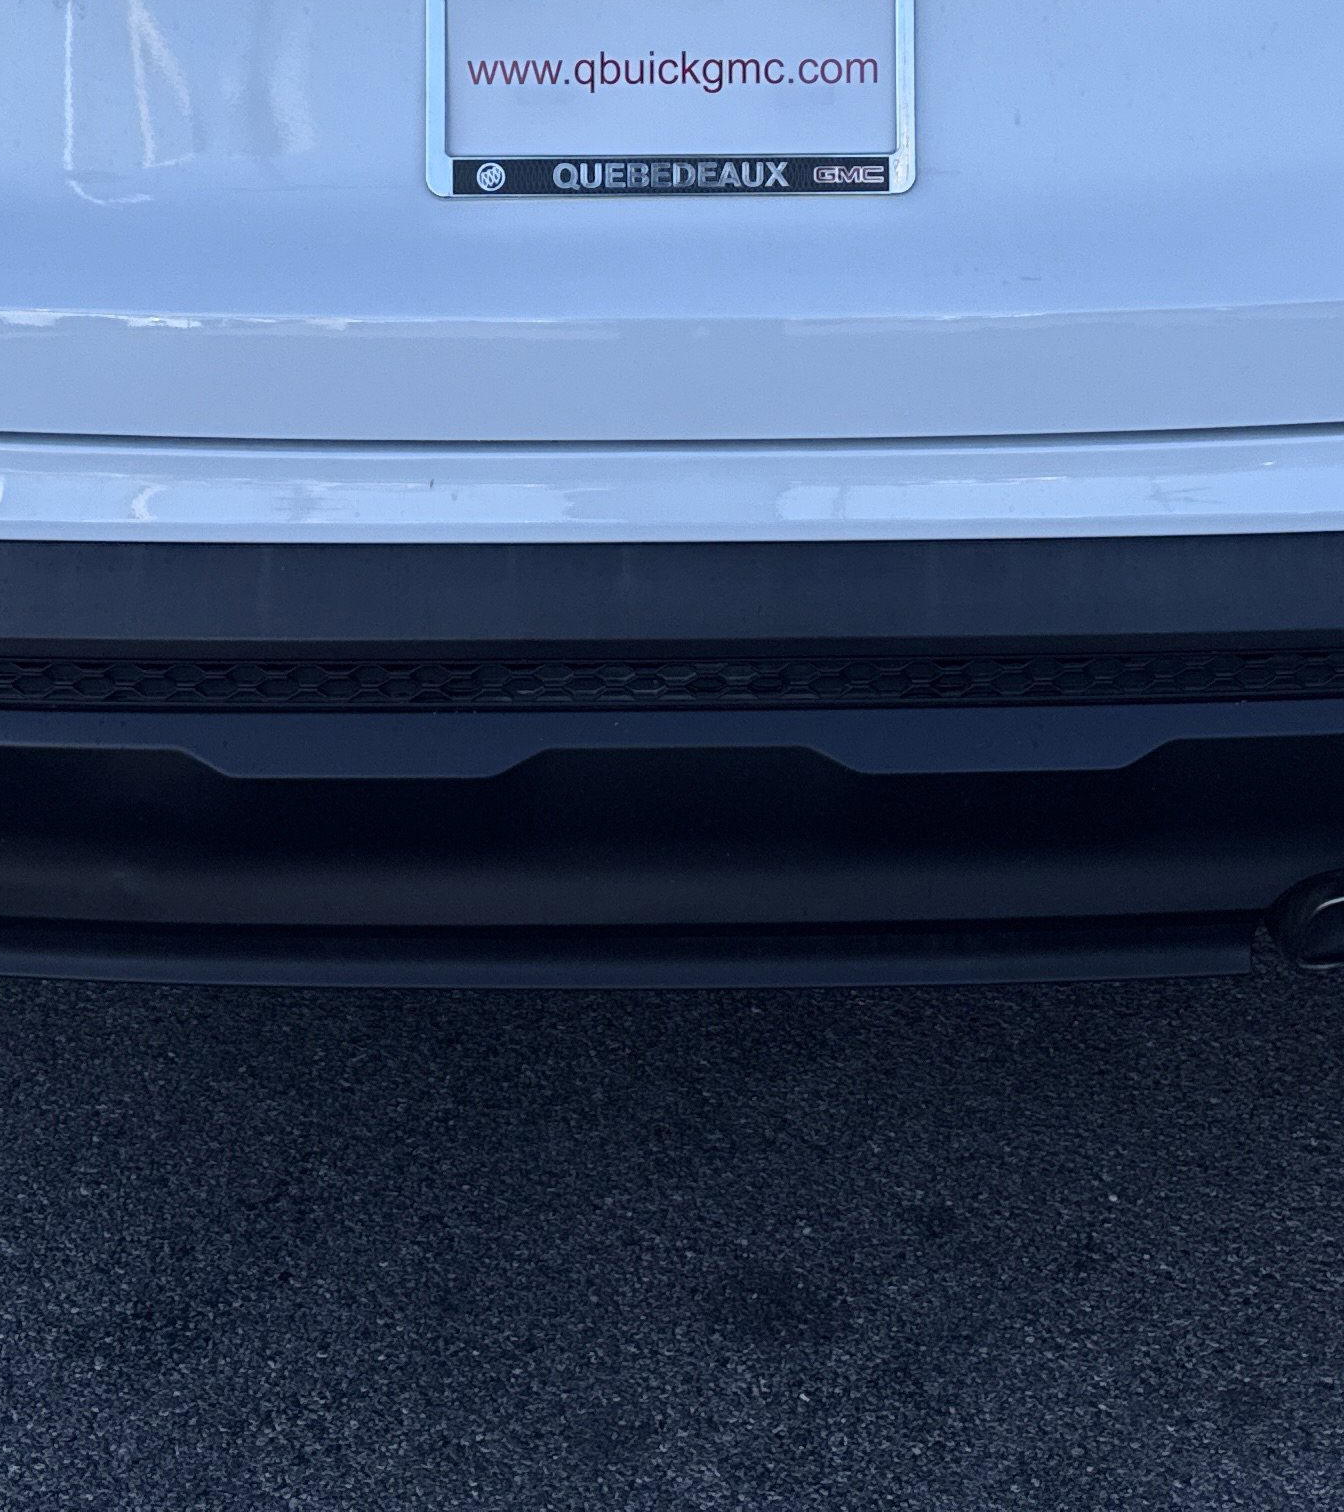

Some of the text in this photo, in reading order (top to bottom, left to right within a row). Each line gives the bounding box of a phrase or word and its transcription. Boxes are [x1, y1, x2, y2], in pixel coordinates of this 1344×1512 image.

[467, 51, 879, 94] www.qbuickgmc.com
[552, 162, 789, 190] QUEBEDEAUX
[813, 165, 885, 184] GMC
